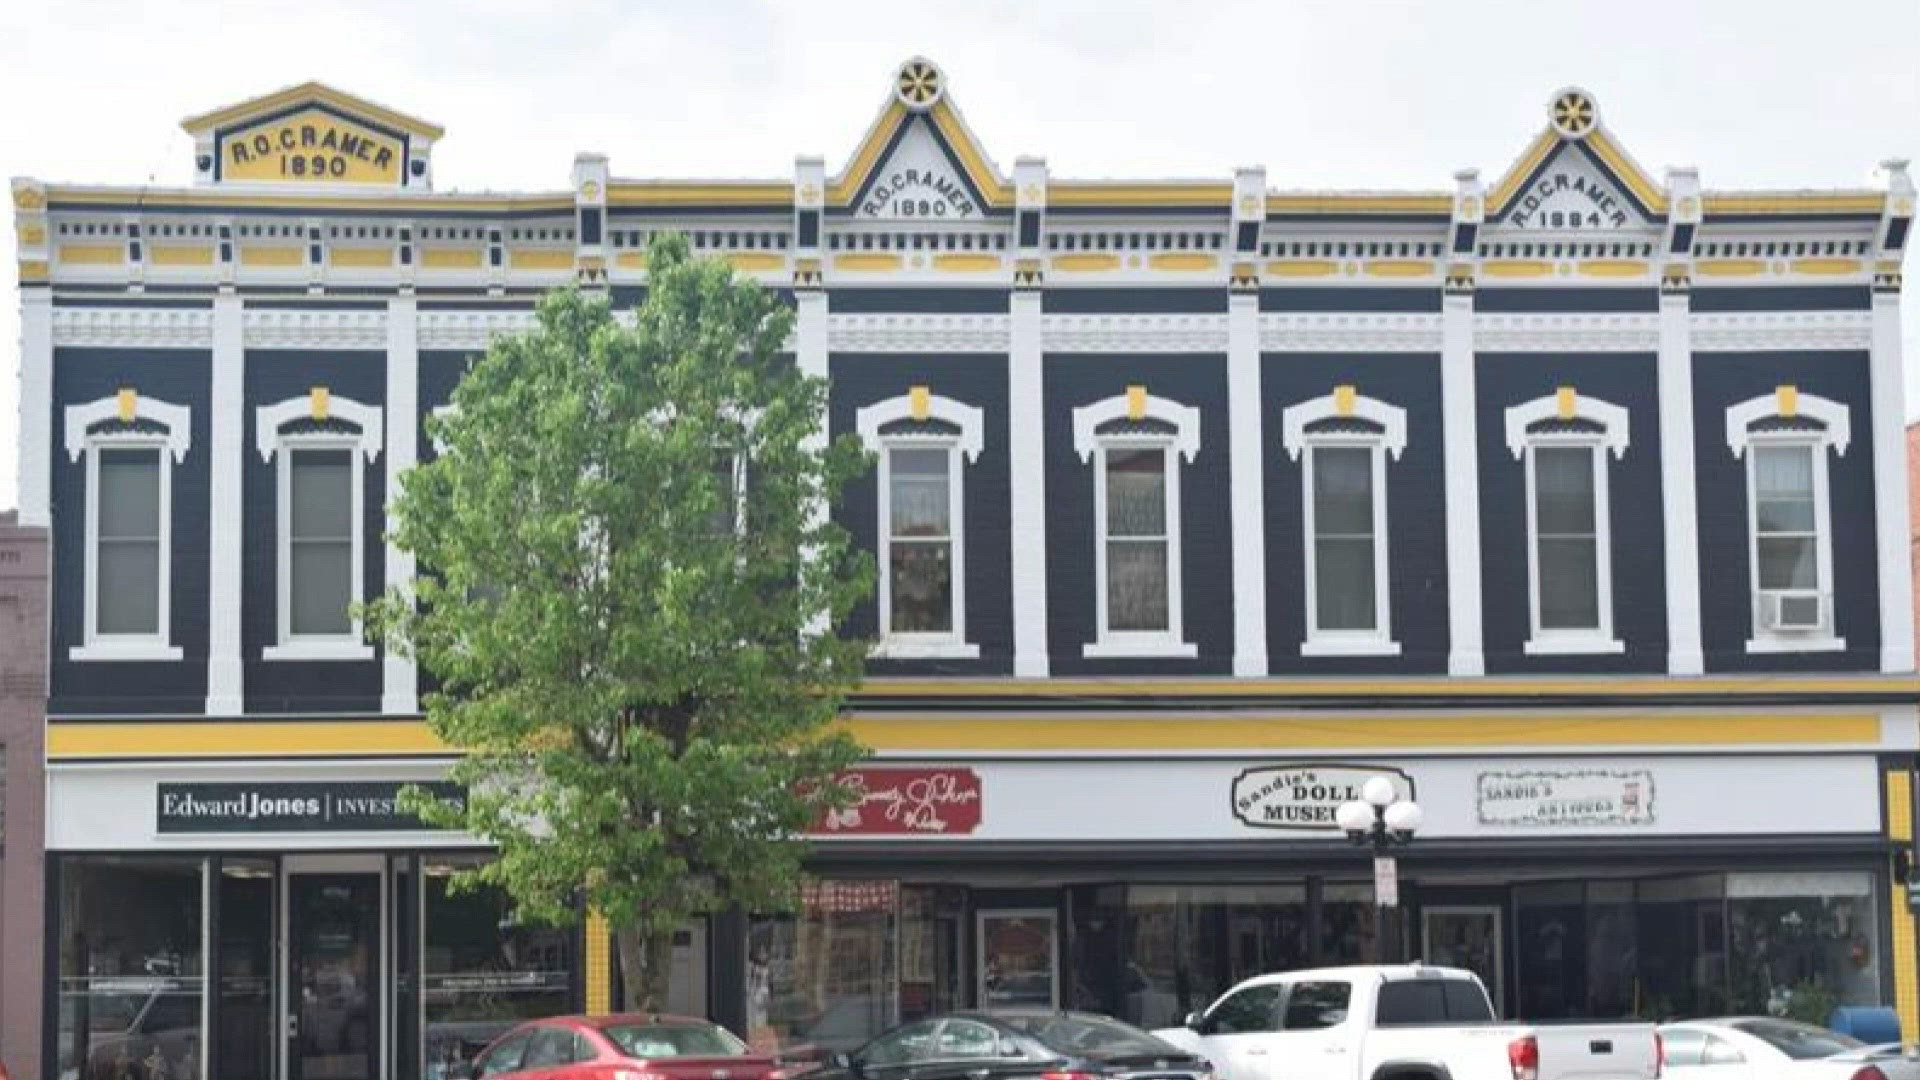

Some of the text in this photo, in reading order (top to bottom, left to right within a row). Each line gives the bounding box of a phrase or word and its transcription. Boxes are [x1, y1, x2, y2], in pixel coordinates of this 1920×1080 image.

[281, 154, 347, 177] 1890
[893, 200, 946, 216] 1890
[1292, 784, 1359, 801] DOLL
